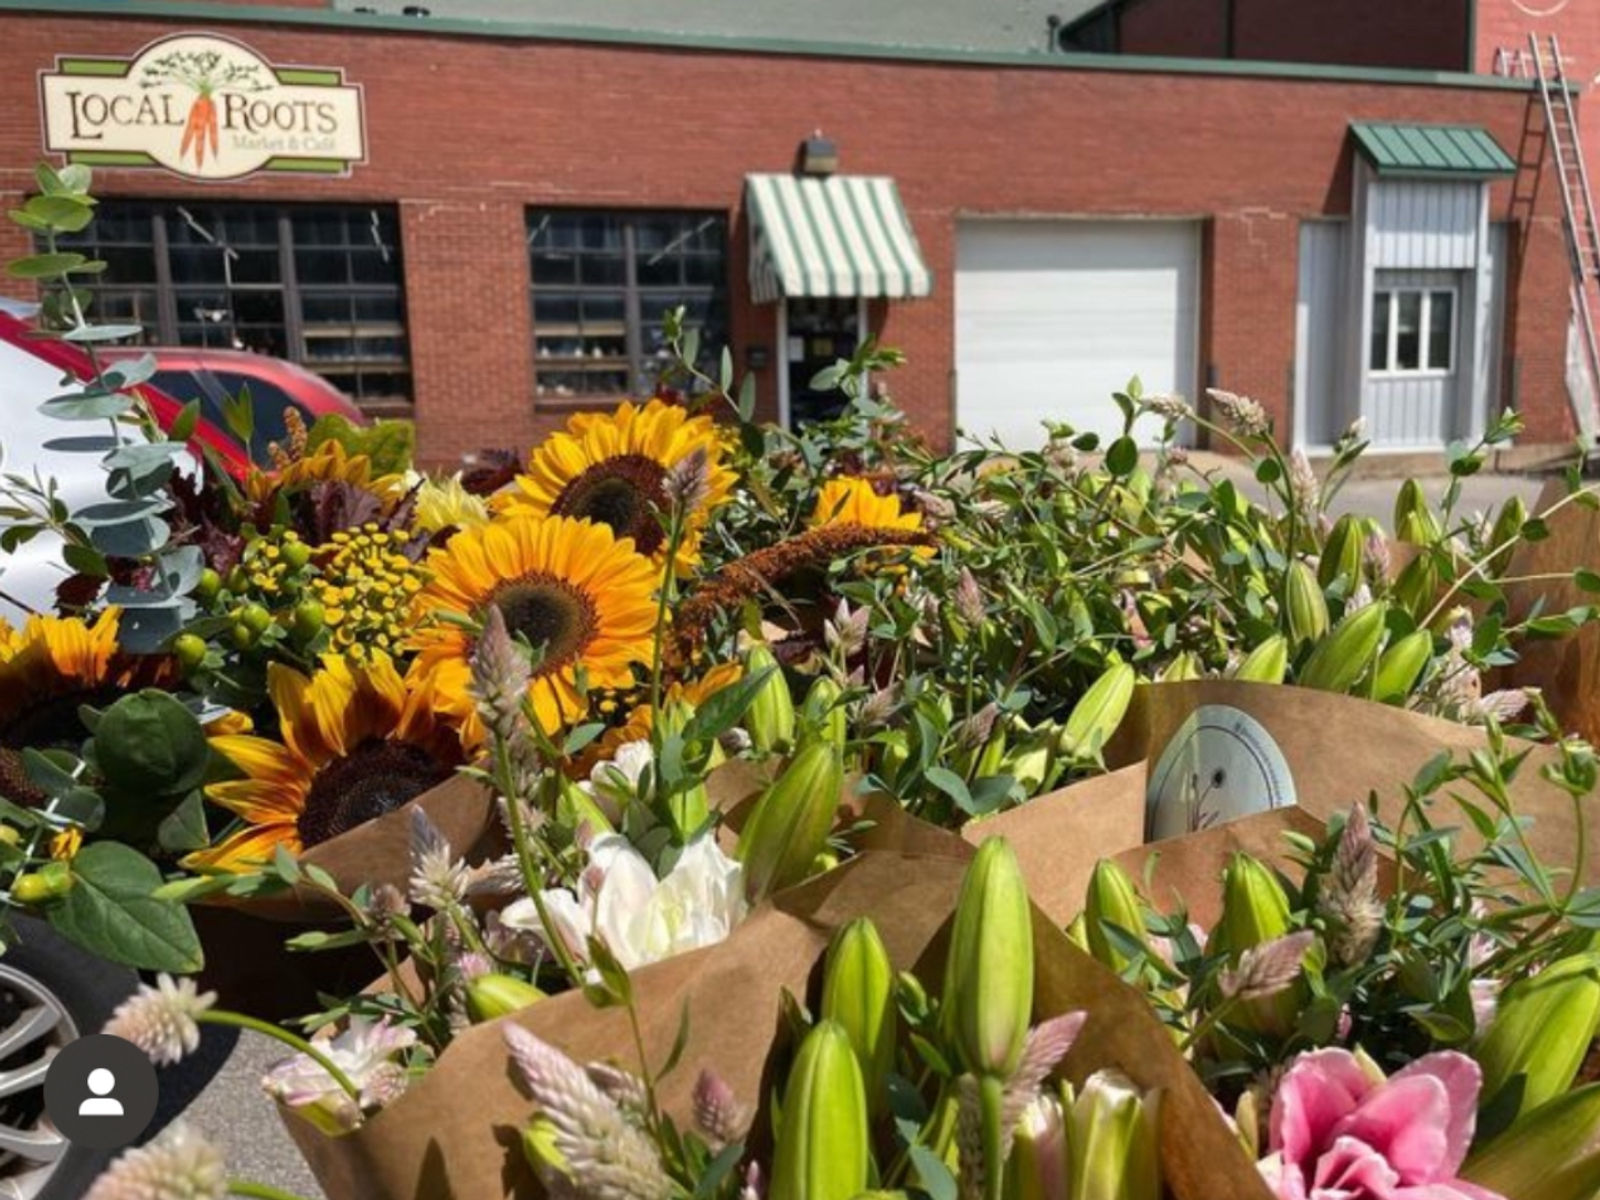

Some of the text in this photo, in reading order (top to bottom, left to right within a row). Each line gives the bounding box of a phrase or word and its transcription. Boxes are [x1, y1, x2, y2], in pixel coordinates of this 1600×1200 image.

[65, 91, 337, 139] LOCAL ROOTS
[232, 134, 283, 150] Market
[288, 135, 300, 150] &
